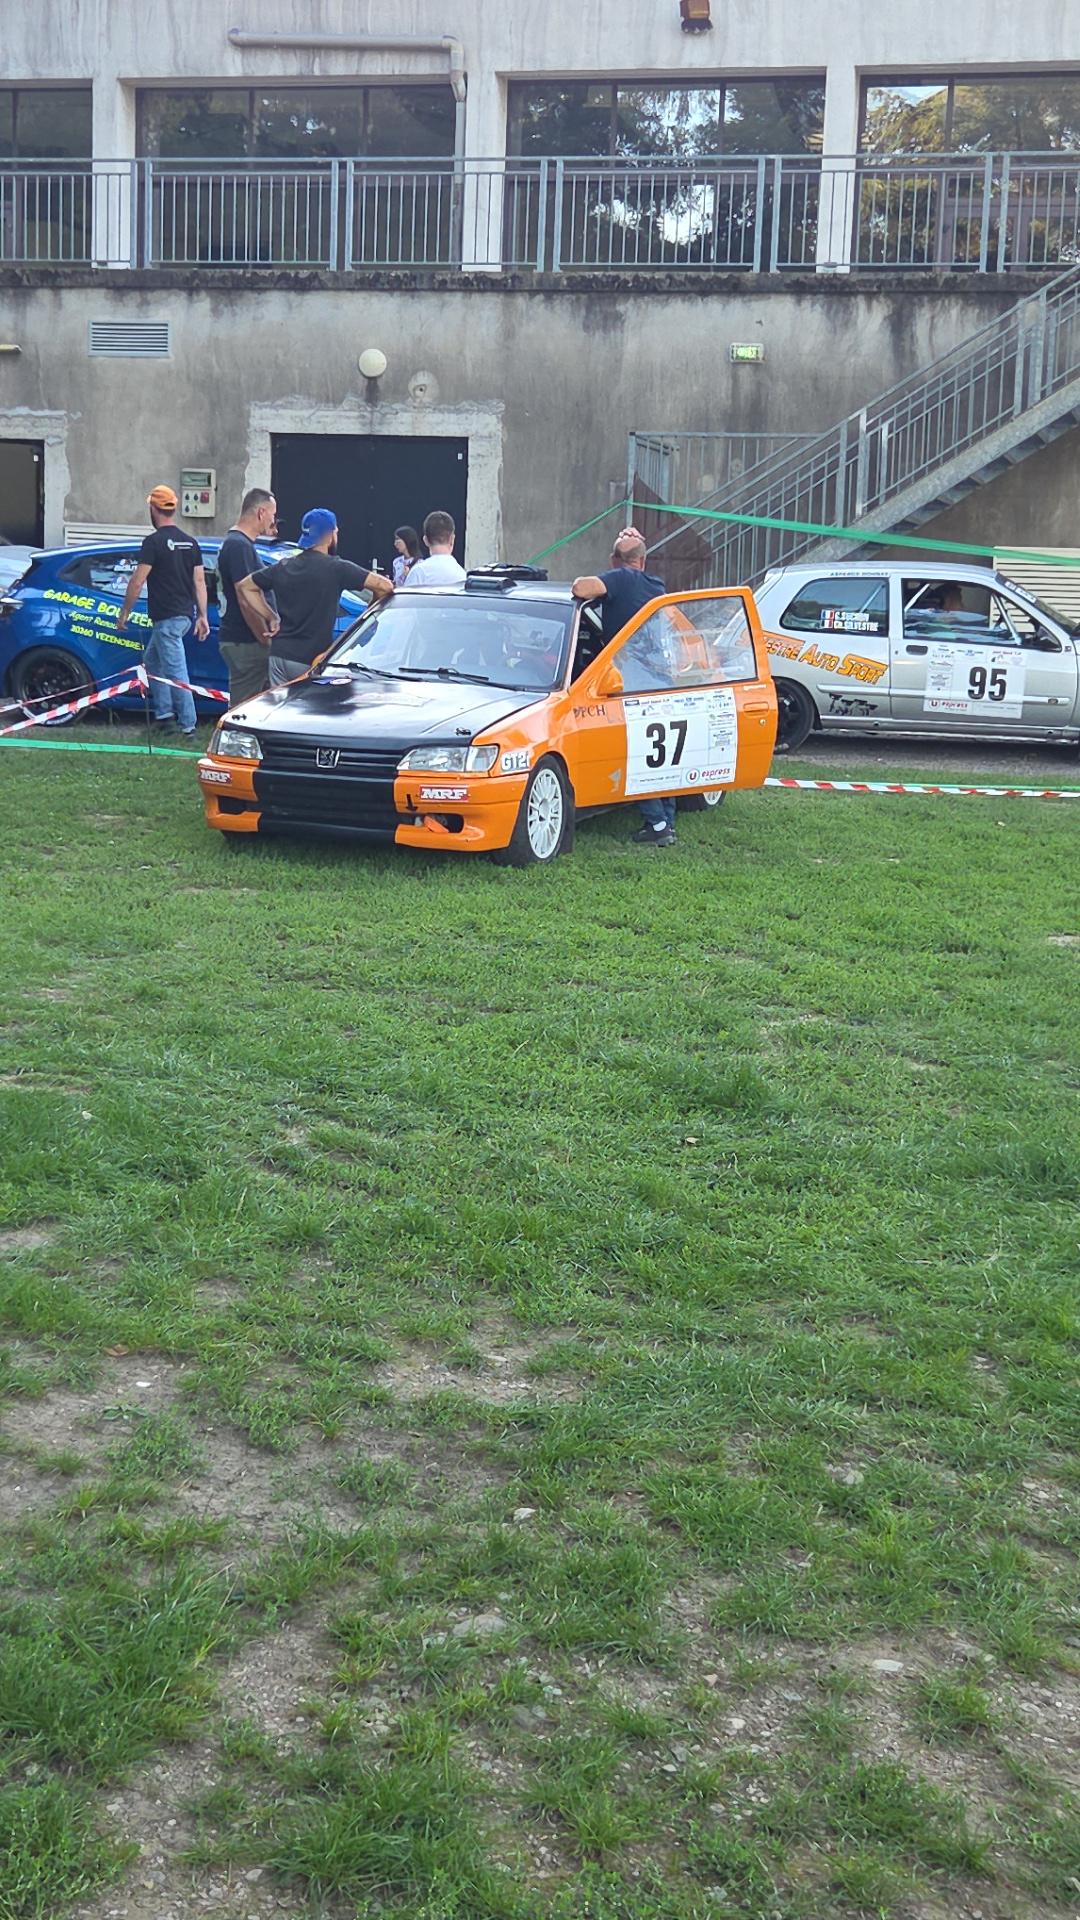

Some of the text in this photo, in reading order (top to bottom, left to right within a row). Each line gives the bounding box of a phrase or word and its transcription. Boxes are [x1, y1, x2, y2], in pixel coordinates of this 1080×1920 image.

[43, 588, 96, 610] GARAGE
[93, 616, 119, 630] Renau
[967, 666, 1007, 701] 95
[646, 719, 688, 769] 37
[200, 768, 231, 783] MRF
[701, 767, 731, 780] express
[420, 787, 468, 800] MRF
